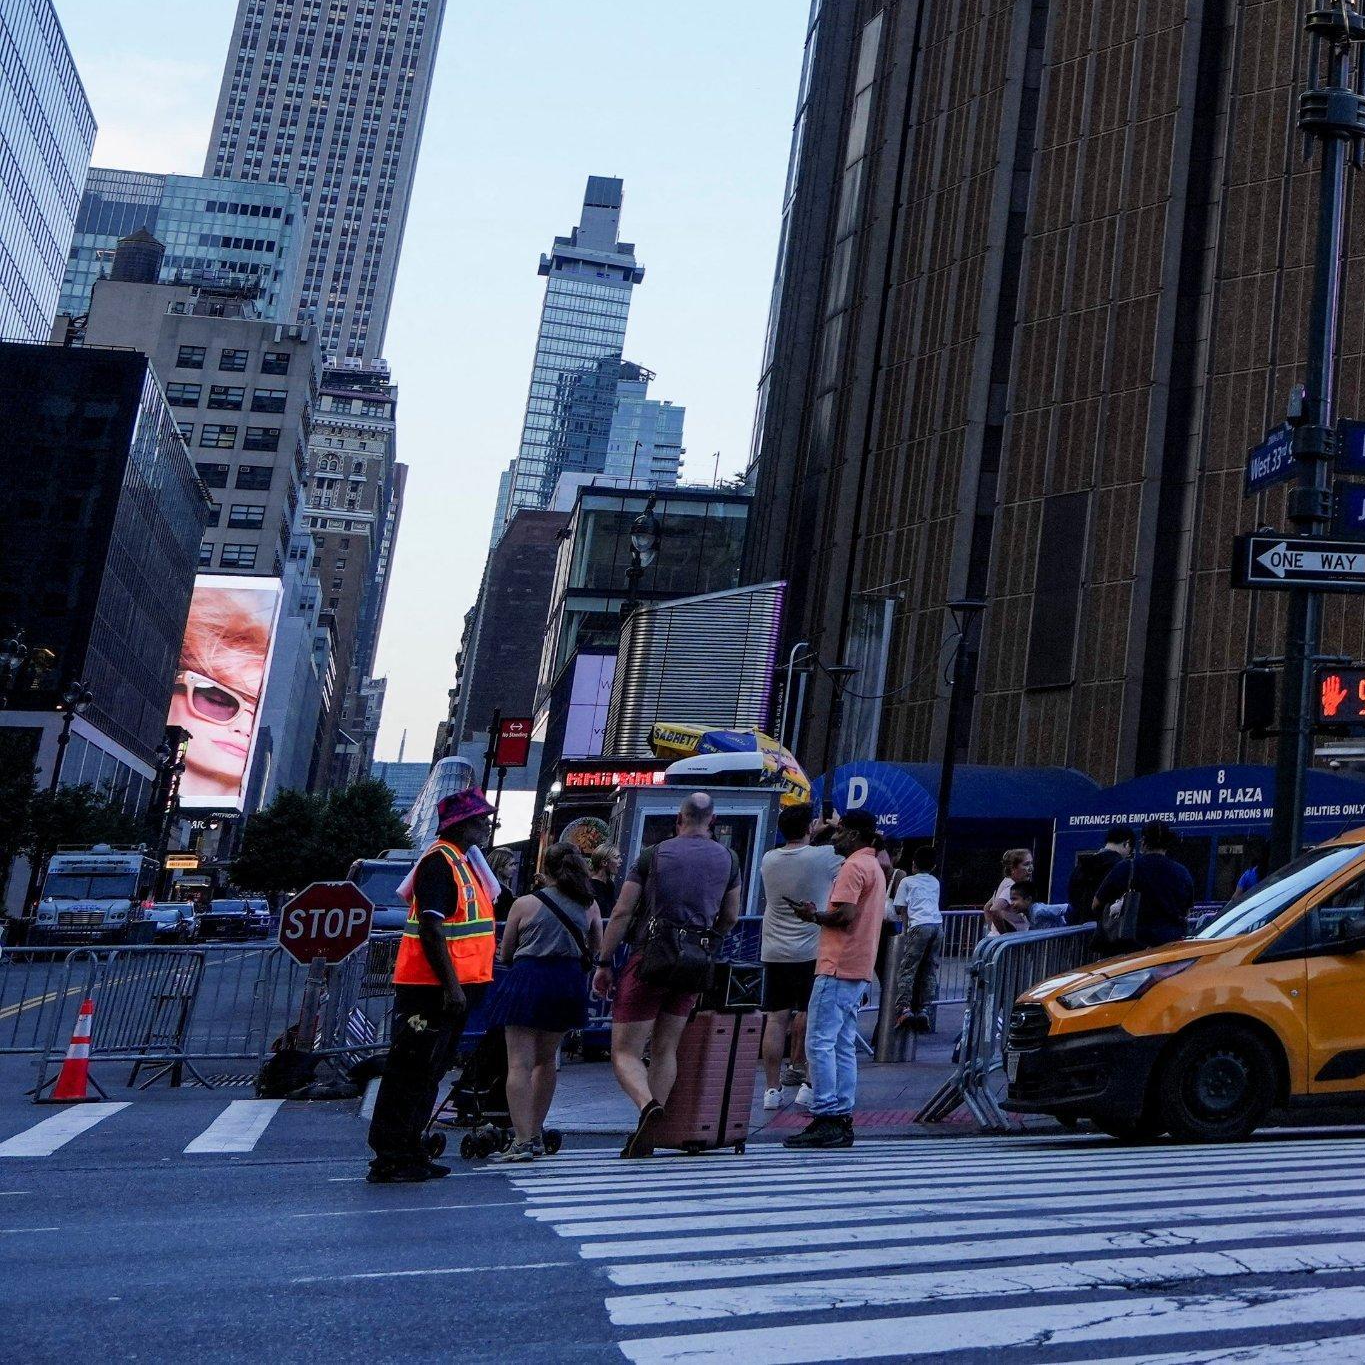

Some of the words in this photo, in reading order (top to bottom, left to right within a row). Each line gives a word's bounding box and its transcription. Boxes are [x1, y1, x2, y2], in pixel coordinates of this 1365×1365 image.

[1250, 453, 1270, 481] West
[1270, 552, 1303, 569] ONE
[1320, 554, 1359, 570] WAY
[1216, 769, 1225, 784] 8
[846, 776, 868, 809] D
[1176, 789, 1211, 805] PENN
[1219, 787, 1263, 804] PLAZA
[1069, 813, 1111, 825] ENTRANCE
[1111, 812, 1127, 824] FOR
[1128, 811, 1177, 824] EMPLOYEES,
[1178, 810, 1203, 822] MEDIA
[1204, 809, 1222, 821] AND
[1224, 808, 1261, 820] PATRONS
[1263, 807, 1274, 819] WI
[1304, 805, 1341, 817] BILITIES
[285, 907, 367, 940] STOP
